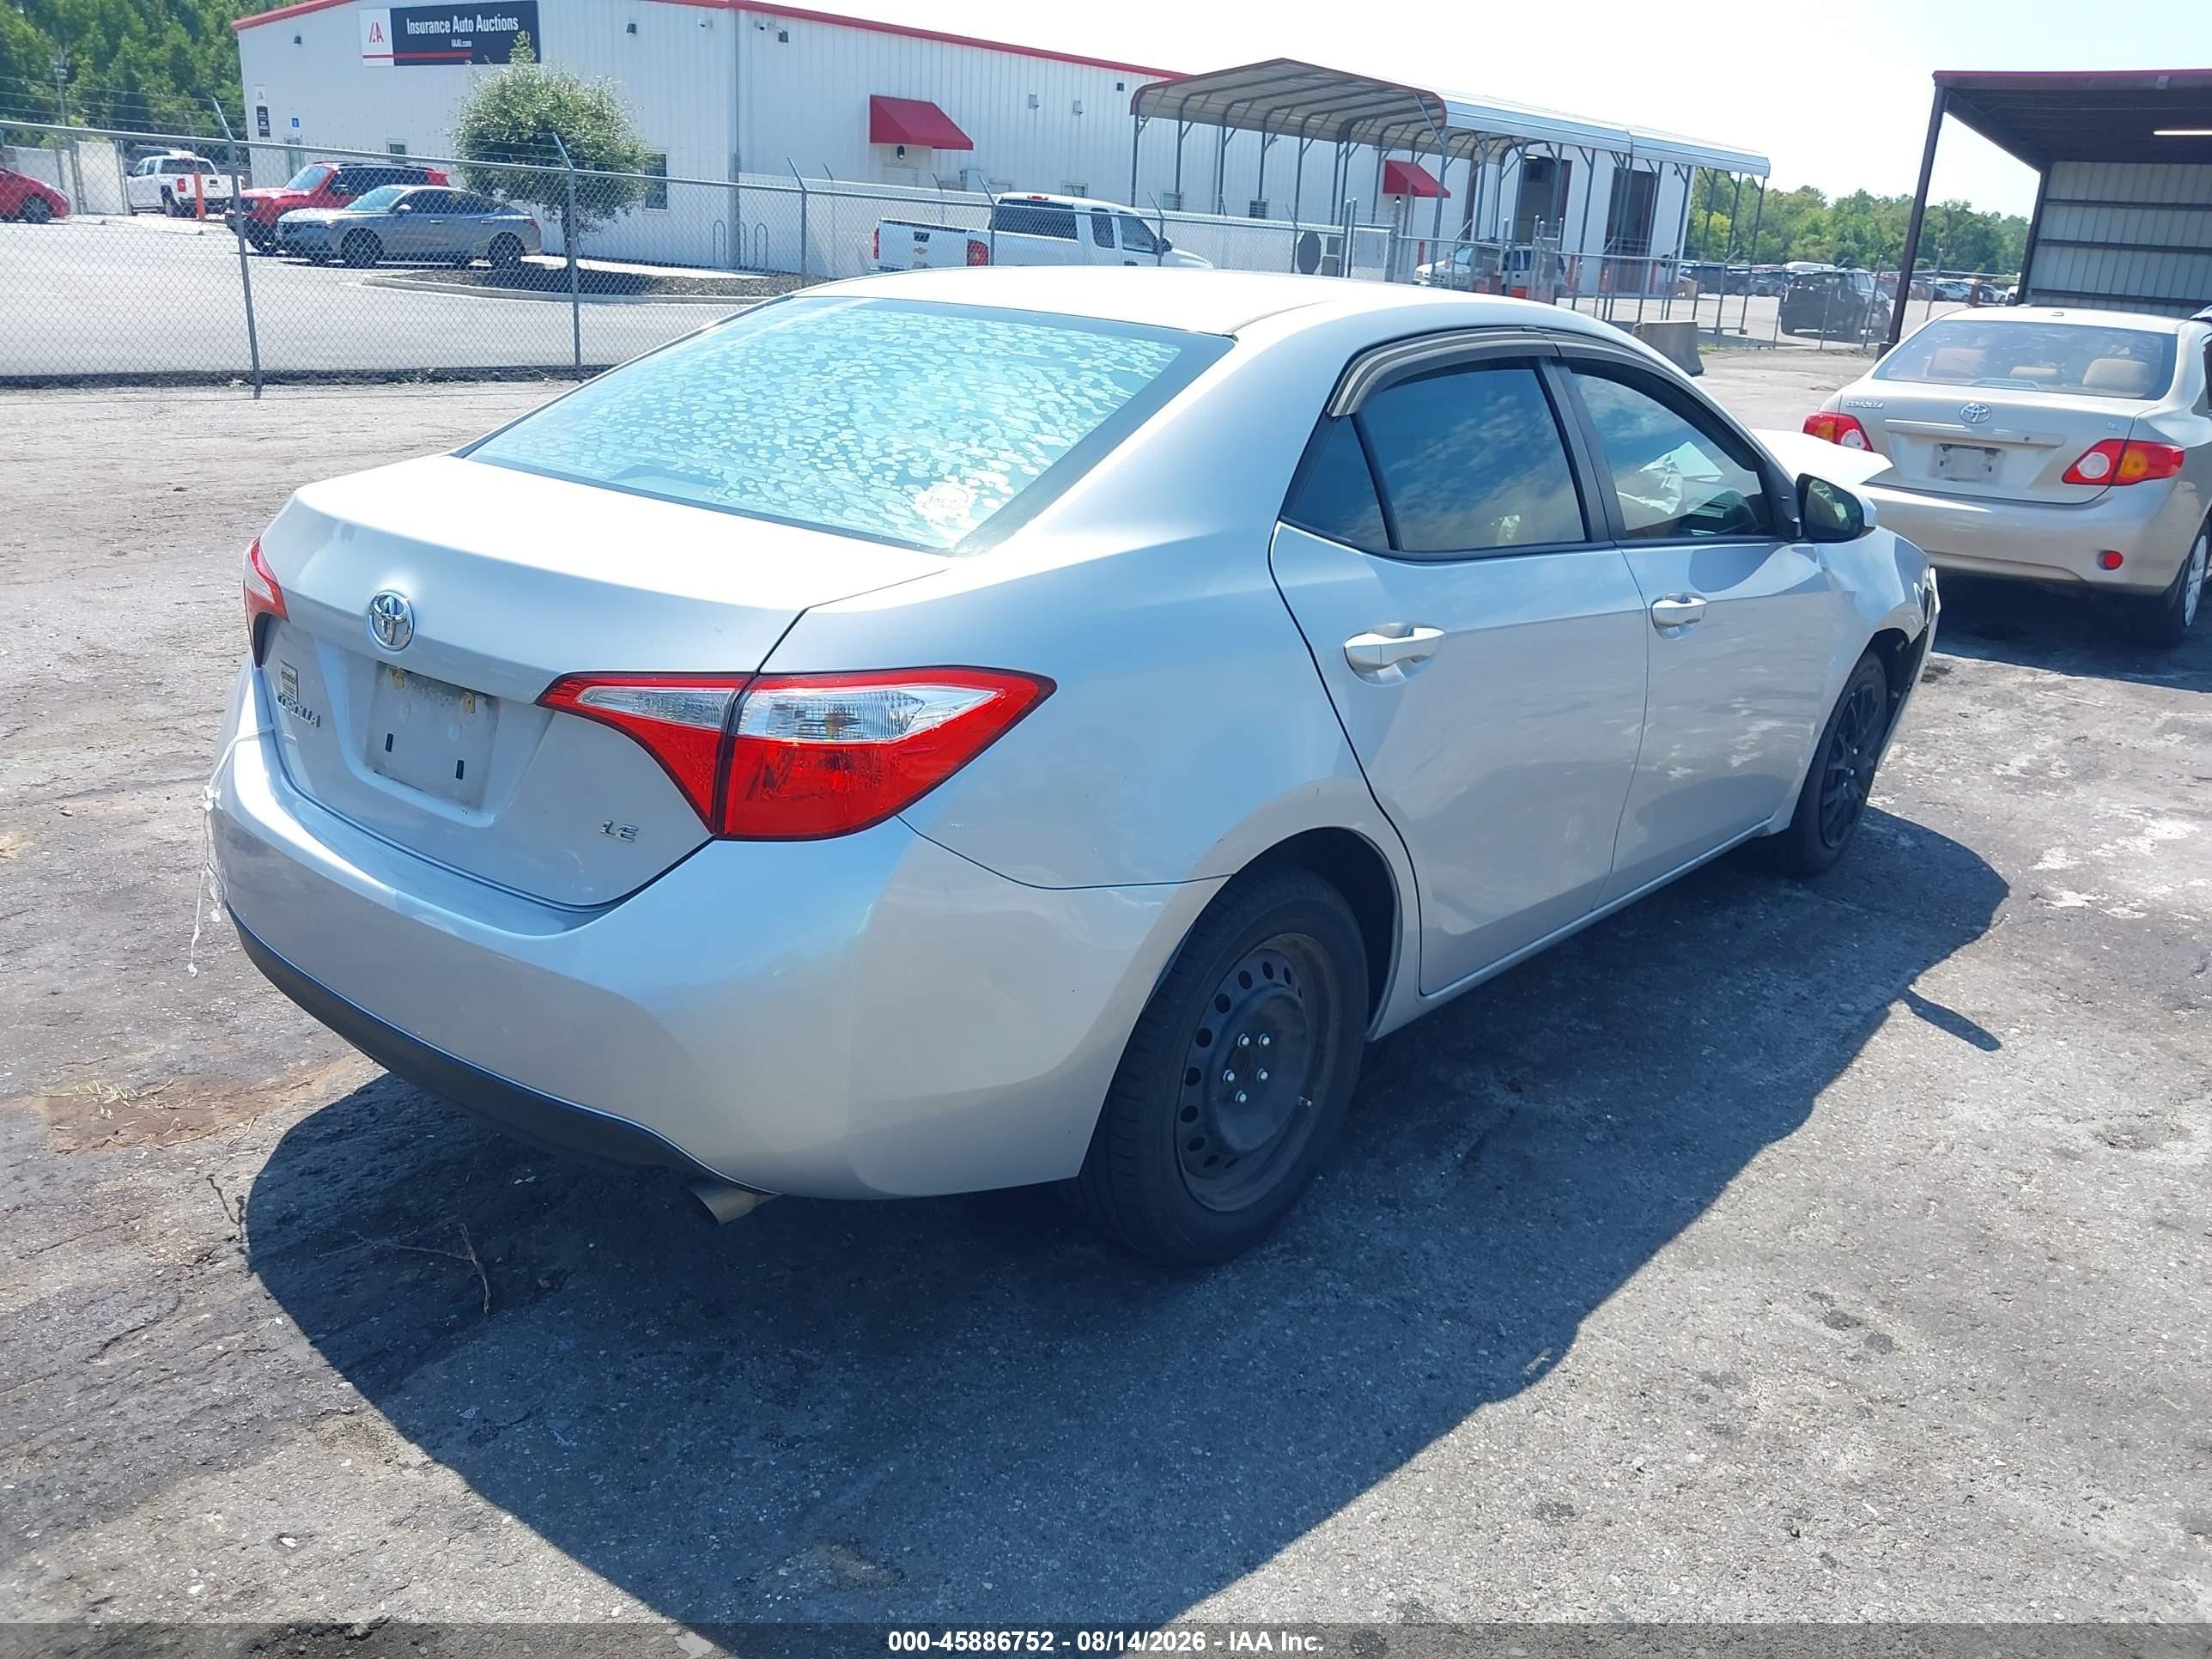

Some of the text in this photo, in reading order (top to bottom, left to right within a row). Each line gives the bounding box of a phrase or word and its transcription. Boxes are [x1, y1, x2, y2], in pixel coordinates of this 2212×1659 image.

[406, 14, 519, 34] Insurance Auto Auctions
[599, 819, 640, 843] LE
